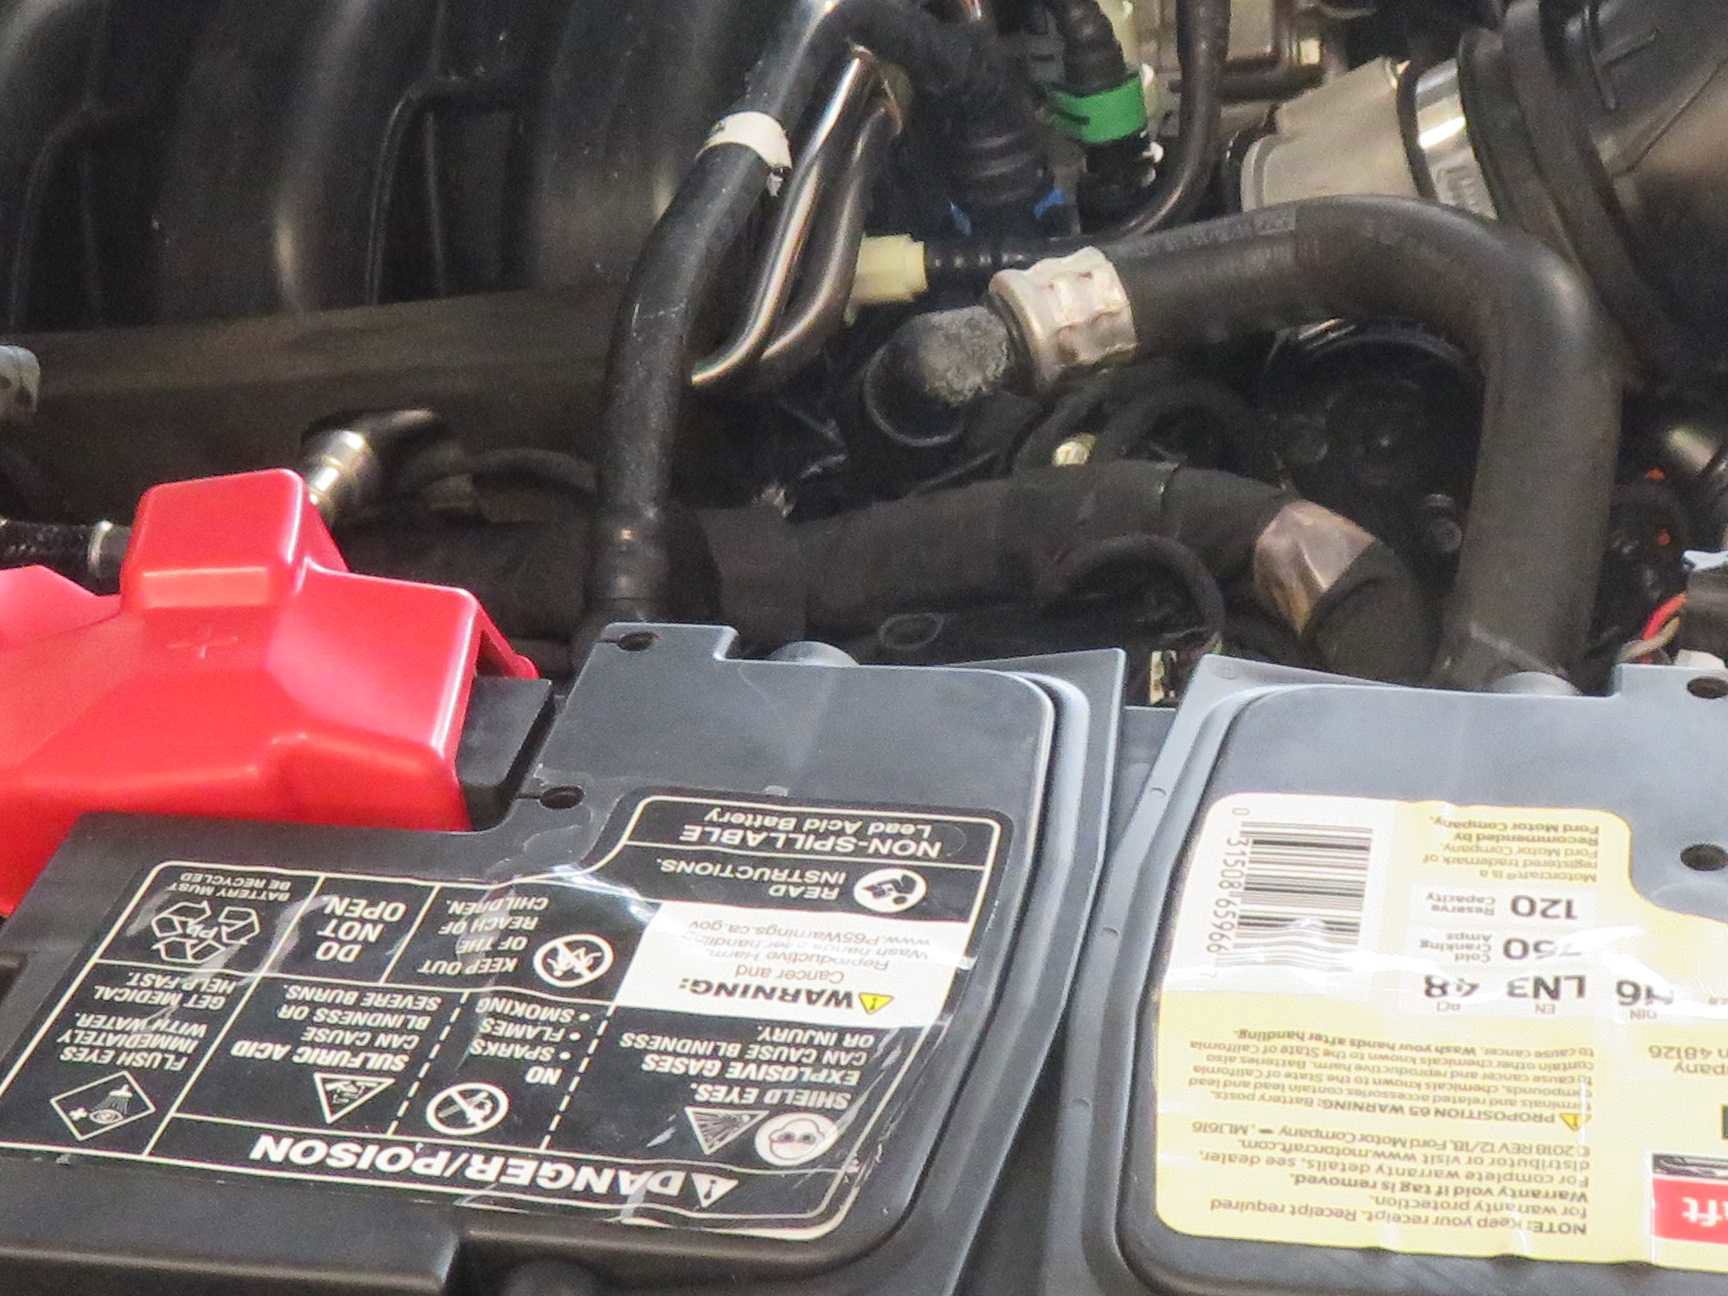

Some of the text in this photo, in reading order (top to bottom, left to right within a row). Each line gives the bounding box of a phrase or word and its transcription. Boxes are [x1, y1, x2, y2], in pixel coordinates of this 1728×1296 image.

[704, 808, 932, 838] Lead Acid Battery
[1428, 815, 1599, 833] Ford Motor Company.
[679, 824, 942, 858] NON-SPILLABLE
[1454, 832, 1599, 846] Recommended by
[1440, 843, 1598, 858] Ford Motor Company.
[655, 859, 846, 883] INSTRUCTIONS.
[1218, 837, 1250, 890] 31508
[1423, 853, 1598, 869] registered trademark of
[180, 872, 292, 891] BE RECYCLED
[167, 882, 290, 902] BATTERY MUST
[768, 884, 840, 900] READ
[1426, 892, 1496, 904] Capacity
[320, 895, 406, 921] OPEN.
[446, 896, 549, 915] CHILDREN.
[1431, 905, 1495, 916] Reserve
[1510, 895, 1577, 920] 120
[316, 919, 384, 942] NOT
[439, 916, 538, 936] REACH OF
[688, 918, 930, 948] www.P65Warnings.ca.gov
[1206, 897, 1237, 954] 65966
[455, 936, 527, 954] OF THE
[1419, 939, 1491, 953] Cranking
[1446, 932, 1492, 942] Amps
[315, 941, 362, 962] DO
[766, 950, 891, 971] Reproductive
[1453, 953, 1491, 963] Cold
[417, 957, 518, 976] KEEP OUT
[735, 964, 845, 984] Cancer and
[127, 971, 236, 992] HELP FAST.
[1506, 975, 1586, 1000] LN3
[93, 985, 226, 1010] GET MEDICAL
[282, 983, 441, 1010] SEVERE BURNS.
[679, 977, 854, 1009] WARNING:
[277, 1004, 431, 1030] BLINDNESS OR
[475, 996, 575, 1021] SMOKING
[1535, 1003, 1556, 1014] EN
[75, 1013, 207, 1037] WITH WATER.
[478, 1018, 565, 1040] FLAMES
[57, 1029, 199, 1053] IMMEDIATELY
[300, 1025, 420, 1049] CAN CAUSE
[757, 1024, 874, 1047] OR INJURY.
[60, 1046, 188, 1071] FLUSH EYES
[230, 1040, 408, 1071] SULFURIC ACID
[469, 1040, 555, 1061] SPARKS
[620, 1031, 867, 1066] CAN CAUSE BLINDNESS
[1648, 1045, 1713, 1060] 48126
[525, 1065, 562, 1084] NO
[642, 1054, 861, 1086] EXPLOSIVE GASES
[690, 1083, 852, 1110] SHIELD EYES.
[1257, 1093, 1314, 1107] Battery
[1317, 1099, 1405, 1115] WARNING:
[1409, 1106, 1430, 1116] 65
[1434, 1108, 1555, 1124] PROPOSITION
[1279, 1125, 1356, 1143] Company
[1357, 1132, 1407, 1148] Motor
[1238, 1139, 1590, 1171] distributor or visit www.motorcraft.com.
[1410, 1139, 1447, 1151] Ford
[1497, 1143, 1533, 1155] REV
[1536, 1144, 1574, 1156] 2018
[249, 1134, 687, 1197] DANGER/POISON
[1265, 1157, 1296, 1168] see
[1375, 1164, 1460, 1181] warranty
[1464, 1171, 1554, 1184] complete
[1560, 1176, 1589, 1187] For
[1289, 1174, 1588, 1203] Warranty void if tag is removed.
[1209, 1199, 1285, 1214] required
[1289, 1204, 1357, 1221] Receipt
[1369, 1195, 1587, 1219] for warranty protection.
[1361, 1209, 1429, 1225] receipt.
[1433, 1214, 1472, 1227] your
[1527, 1220, 1587, 1235] NOTE:
